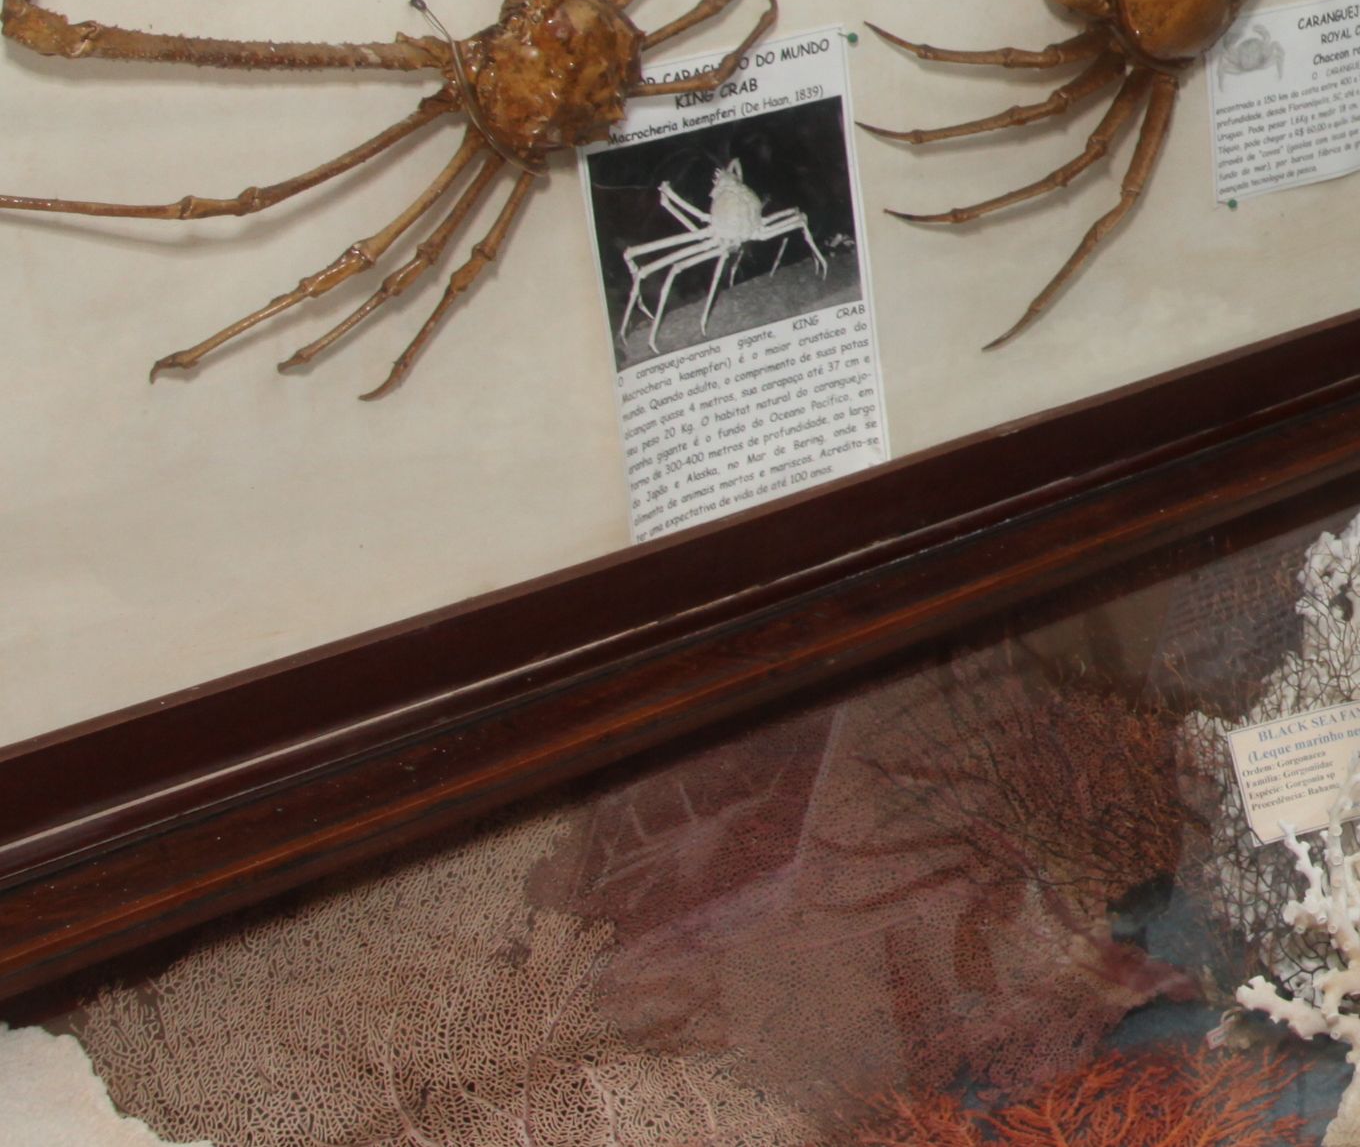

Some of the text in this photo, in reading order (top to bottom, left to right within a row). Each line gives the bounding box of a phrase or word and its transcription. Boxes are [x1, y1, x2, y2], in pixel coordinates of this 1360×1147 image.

[1320, 27, 1351, 44] ROYAL
[755, 50, 775, 67] DO
[780, 38, 829, 61] MUNDO
[1312, 49, 1349, 65] Chaceon
[720, 78, 757, 98] CRAB
[608, 121, 678, 146] Macrocheria
[682, 109, 736, 128] kaempferi
[741, 102, 759, 117] (De
[795, 85, 823, 102] 1839)
[635, 344, 720, 379] caranguejo-aranha
[792, 314, 819, 331] KING
[836, 303, 865, 319] CRAB
[622, 377, 672, 403] Macrocheria
[678, 356, 731, 381] kaempferi)
[738, 354, 744, 363] é
[764, 341, 791, 356] maior
[798, 327, 846, 346] crustáceo
[853, 320, 867, 332] do
[1258, 720, 1308, 743] BLACK
[1311, 715, 1337, 729] SEA
[1248, 745, 1291, 764] (Leque
[1295, 731, 1344, 751] marinho
